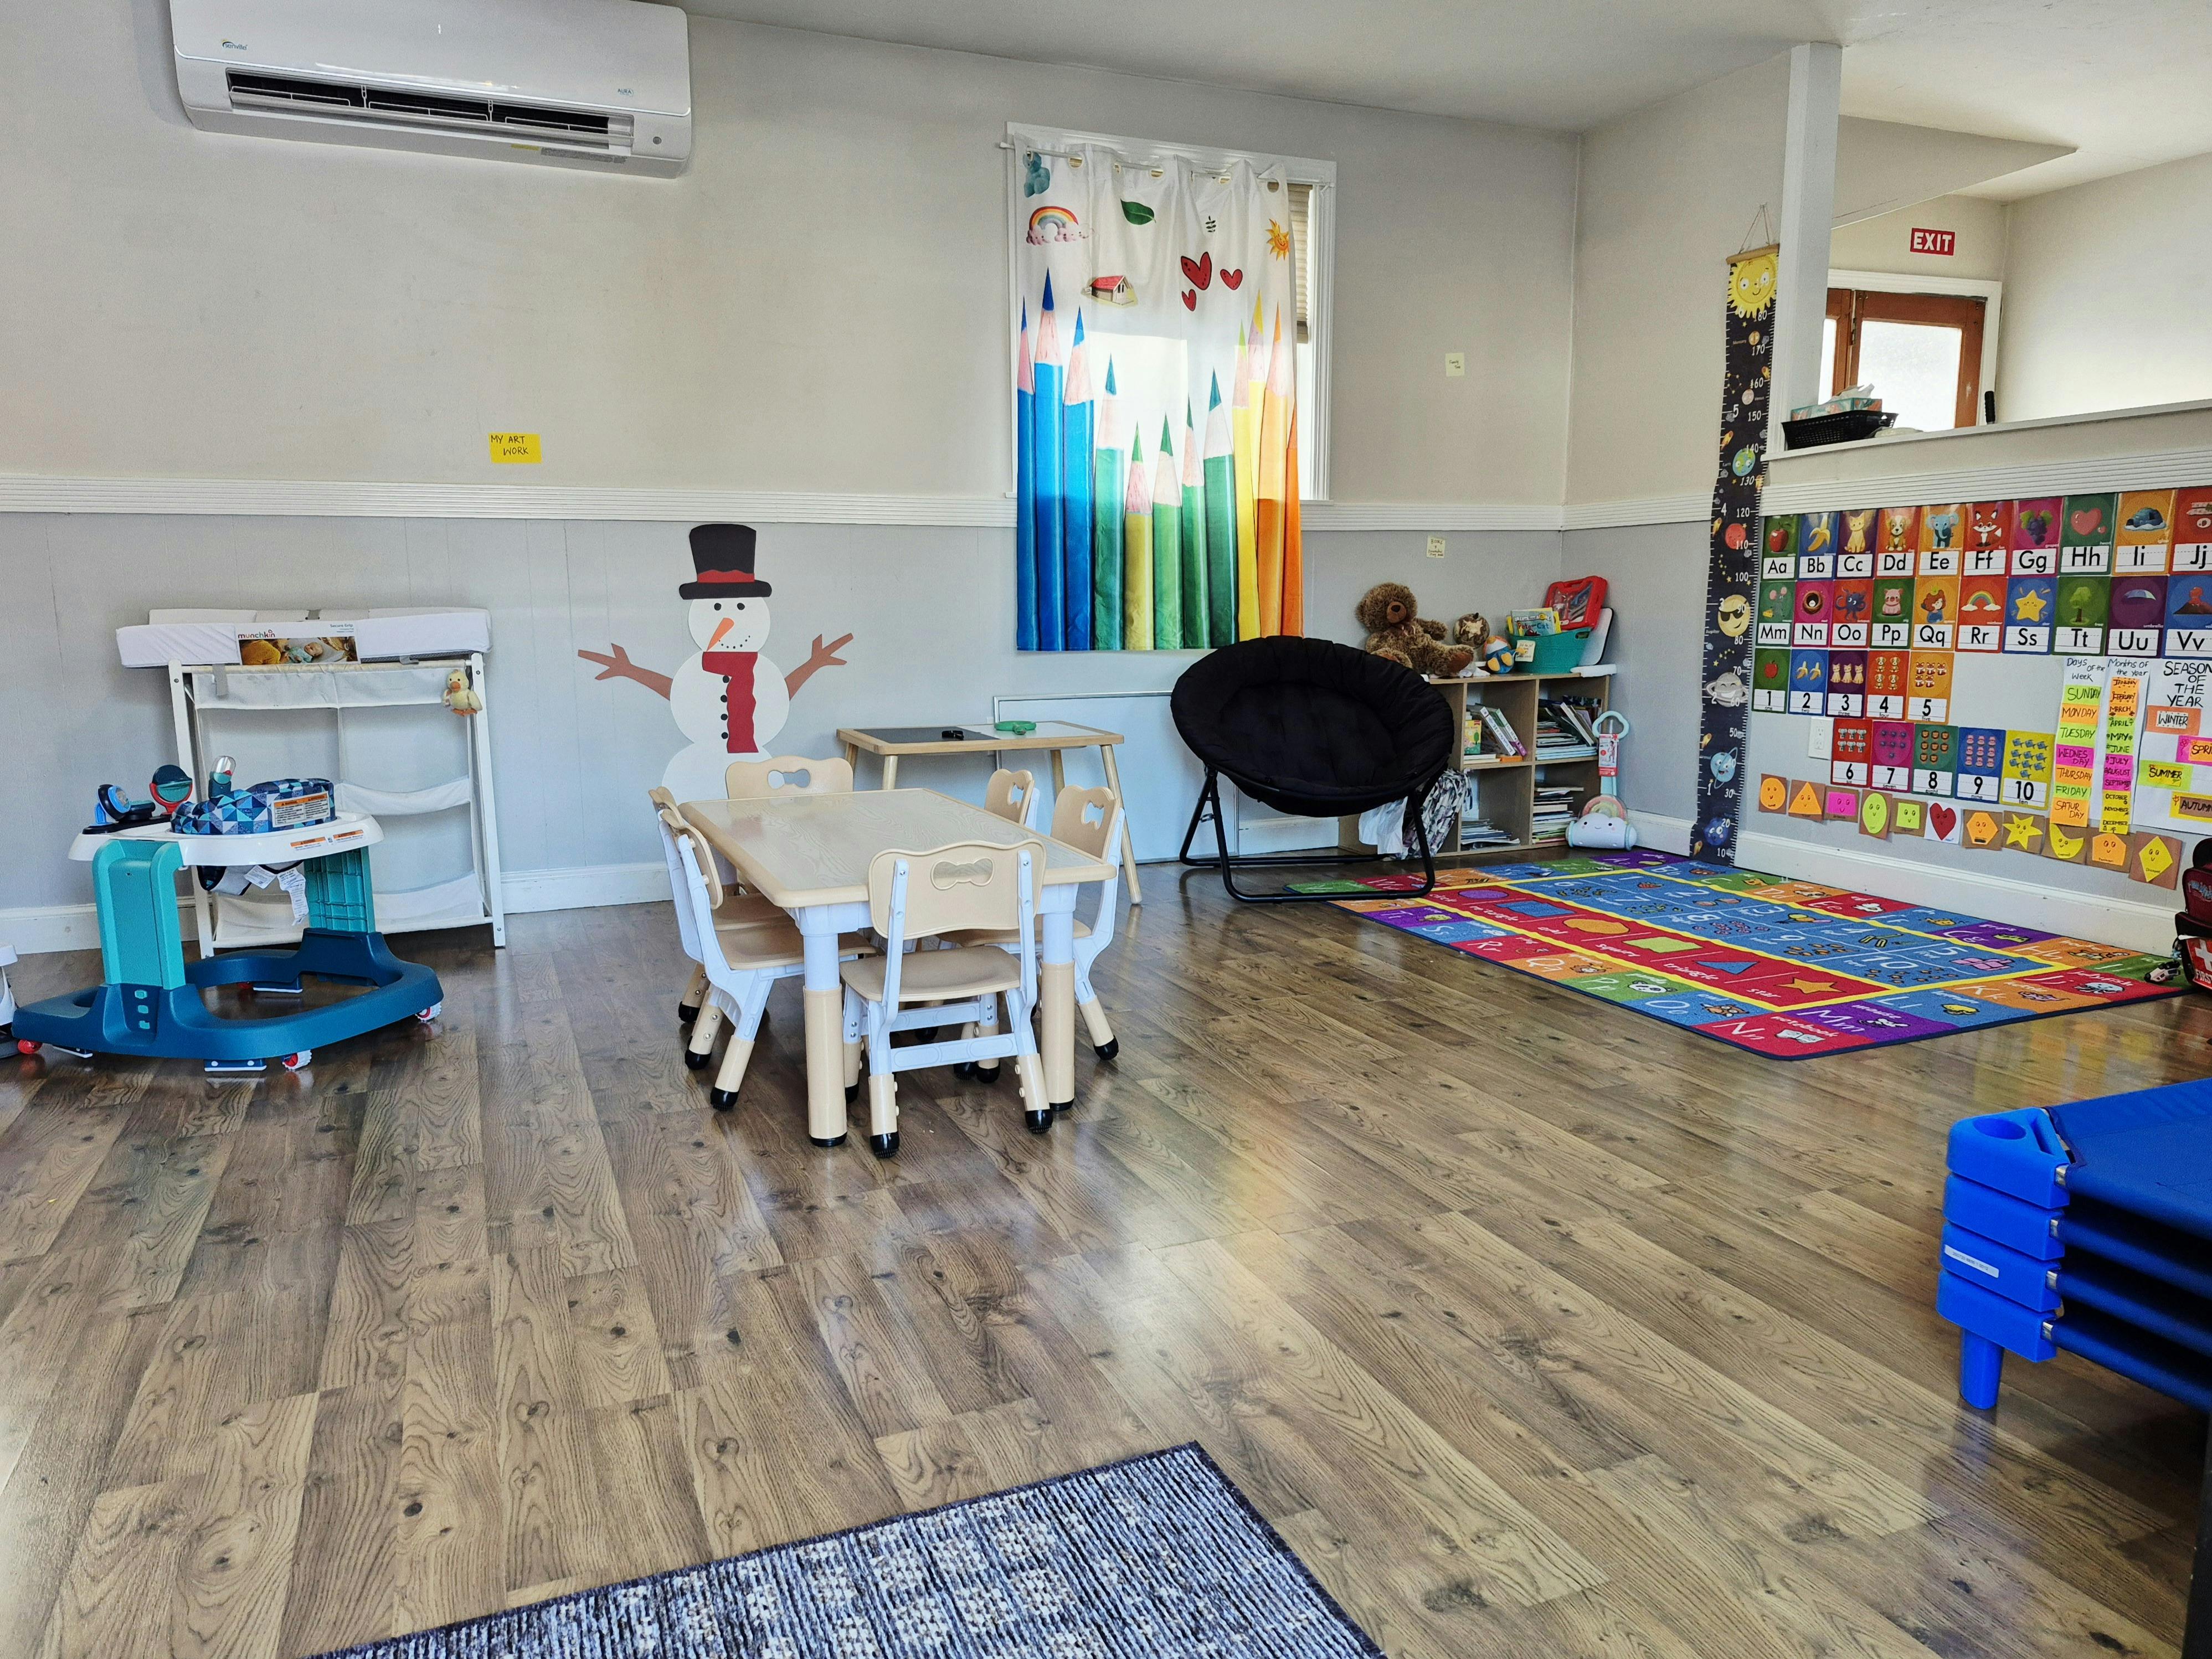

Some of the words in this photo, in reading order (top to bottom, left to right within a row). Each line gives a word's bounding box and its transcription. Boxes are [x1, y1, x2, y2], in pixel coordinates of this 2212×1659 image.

[1913, 231, 1952, 252] EXIT
[1753, 310, 1767, 322] 180
[1752, 344, 1765, 356] 170
[1750, 377, 1763, 389] 160
[1733, 404, 1739, 418] 5
[1748, 410, 1761, 422] 150
[491, 435, 503, 444] MY
[508, 435, 525, 444] ART
[503, 446, 529, 456] WORK
[1746, 442, 1759, 454] 140
[1740, 476, 1755, 486] 130
[1721, 503, 1727, 516] 4
[1737, 507, 1750, 518] 120
[1736, 539, 1748, 550] 110
[1844, 556, 1863, 571] Cc
[1884, 553, 1906, 570] Dd
[1930, 552, 1949, 570] Ee
[1975, 550, 1994, 569] Ff
[2019, 550, 2047, 573] Gg
[2072, 547, 2100, 566] Hh
[2190, 545, 2208, 569] Jj
[1768, 559, 1787, 574] Aa
[1807, 557, 1825, 573] Bb
[1735, 572, 1749, 582] 100
[1737, 604, 1746, 614] 90
[238, 629, 275, 638] munchkin
[1761, 625, 1787, 639] Mm
[1802, 625, 1822, 640] Nn
[1838, 624, 1861, 640] Oo
[1882, 625, 1901, 645] Pp
[1920, 625, 1945, 647] Qq
[1971, 627, 1990, 644] Rr
[2018, 627, 2037, 646] Ss
[2071, 628, 2088, 647] Tt
[1734, 635, 1743, 645] 80
[2118, 631, 2148, 650] Uu
[2177, 631, 2205, 651] Vv
[2067, 658, 2087, 668] Days
[2108, 658, 2137, 668] Months
[1733, 666, 1741, 676] 70
[2188, 675, 2207, 684] OF
[2067, 687, 2102, 701] SUNDAY
[2174, 683, 2205, 694] THE
[1731, 697, 1740, 707] 60
[1767, 691, 1772, 706] 1
[1802, 692, 1810, 709] 2
[1841, 694, 1850, 711] 3
[1879, 696, 1889, 713] 4
[2167, 694, 2204, 708] YEAR
[1922, 699, 1932, 717] 5
[2061, 707, 2097, 718] MONDAY
[2158, 713, 2189, 725] WINTER
[1730, 728, 1737, 738] 50
[2060, 727, 2096, 739] TUESDAY
[2058, 748, 2088, 759] WEDNES
[2109, 756, 2129, 765] JULY
[2072, 758, 2090, 767] DAY
[1846, 763, 1854, 780] 6
[1887, 767, 1895, 784] 7
[2056, 767, 2093, 781] THURSDAY
[2107, 767, 2131, 776] AUGUST
[2149, 767, 2183, 780] SUMMER
[1928, 771, 1938, 789] 8
[1974, 776, 1983, 794] 9
[1707, 783, 1711, 795] 1
[1724, 789, 1733, 798] 30
[2016, 781, 2034, 801] 10
[2056, 786, 2087, 797] FRIDAY
[2055, 801, 2080, 812] SATUR
[2069, 810, 2085, 820] DAY
[1721, 818, 1730, 828] 20
[1717, 848, 1726, 858] 10
[1469, 905, 1519, 921] rectangle
[1752, 905, 1786, 914] 3
[1686, 914, 1722, 922] 8
[1422, 925, 1454, 935] Ss
[1537, 926, 1568, 935] oval
[1468, 941, 1503, 952] Rr
[1595, 944, 1641, 957] square
[1928, 946, 1968, 956] 5
[2014, 946, 2064, 960] Hh
[1526, 958, 1566, 972] Qq
[1861, 956, 1919, 970] 10
[1663, 963, 1719, 980] triangle
[1580, 977, 1619, 991] Pp
[1747, 988, 1782, 998] star
[1932, 990, 1980, 1004] lemon
[1954, 985, 2007, 999] Kk
[1645, 1000, 1690, 1014] Oo
[1876, 996, 1923, 1009] Ll
[1851, 1004, 1902, 1019] mouse
[1771, 1016, 1840, 1038] notebook
[1796, 1009, 1866, 1033] Mm
[1712, 1022, 1766, 1040] Nn
